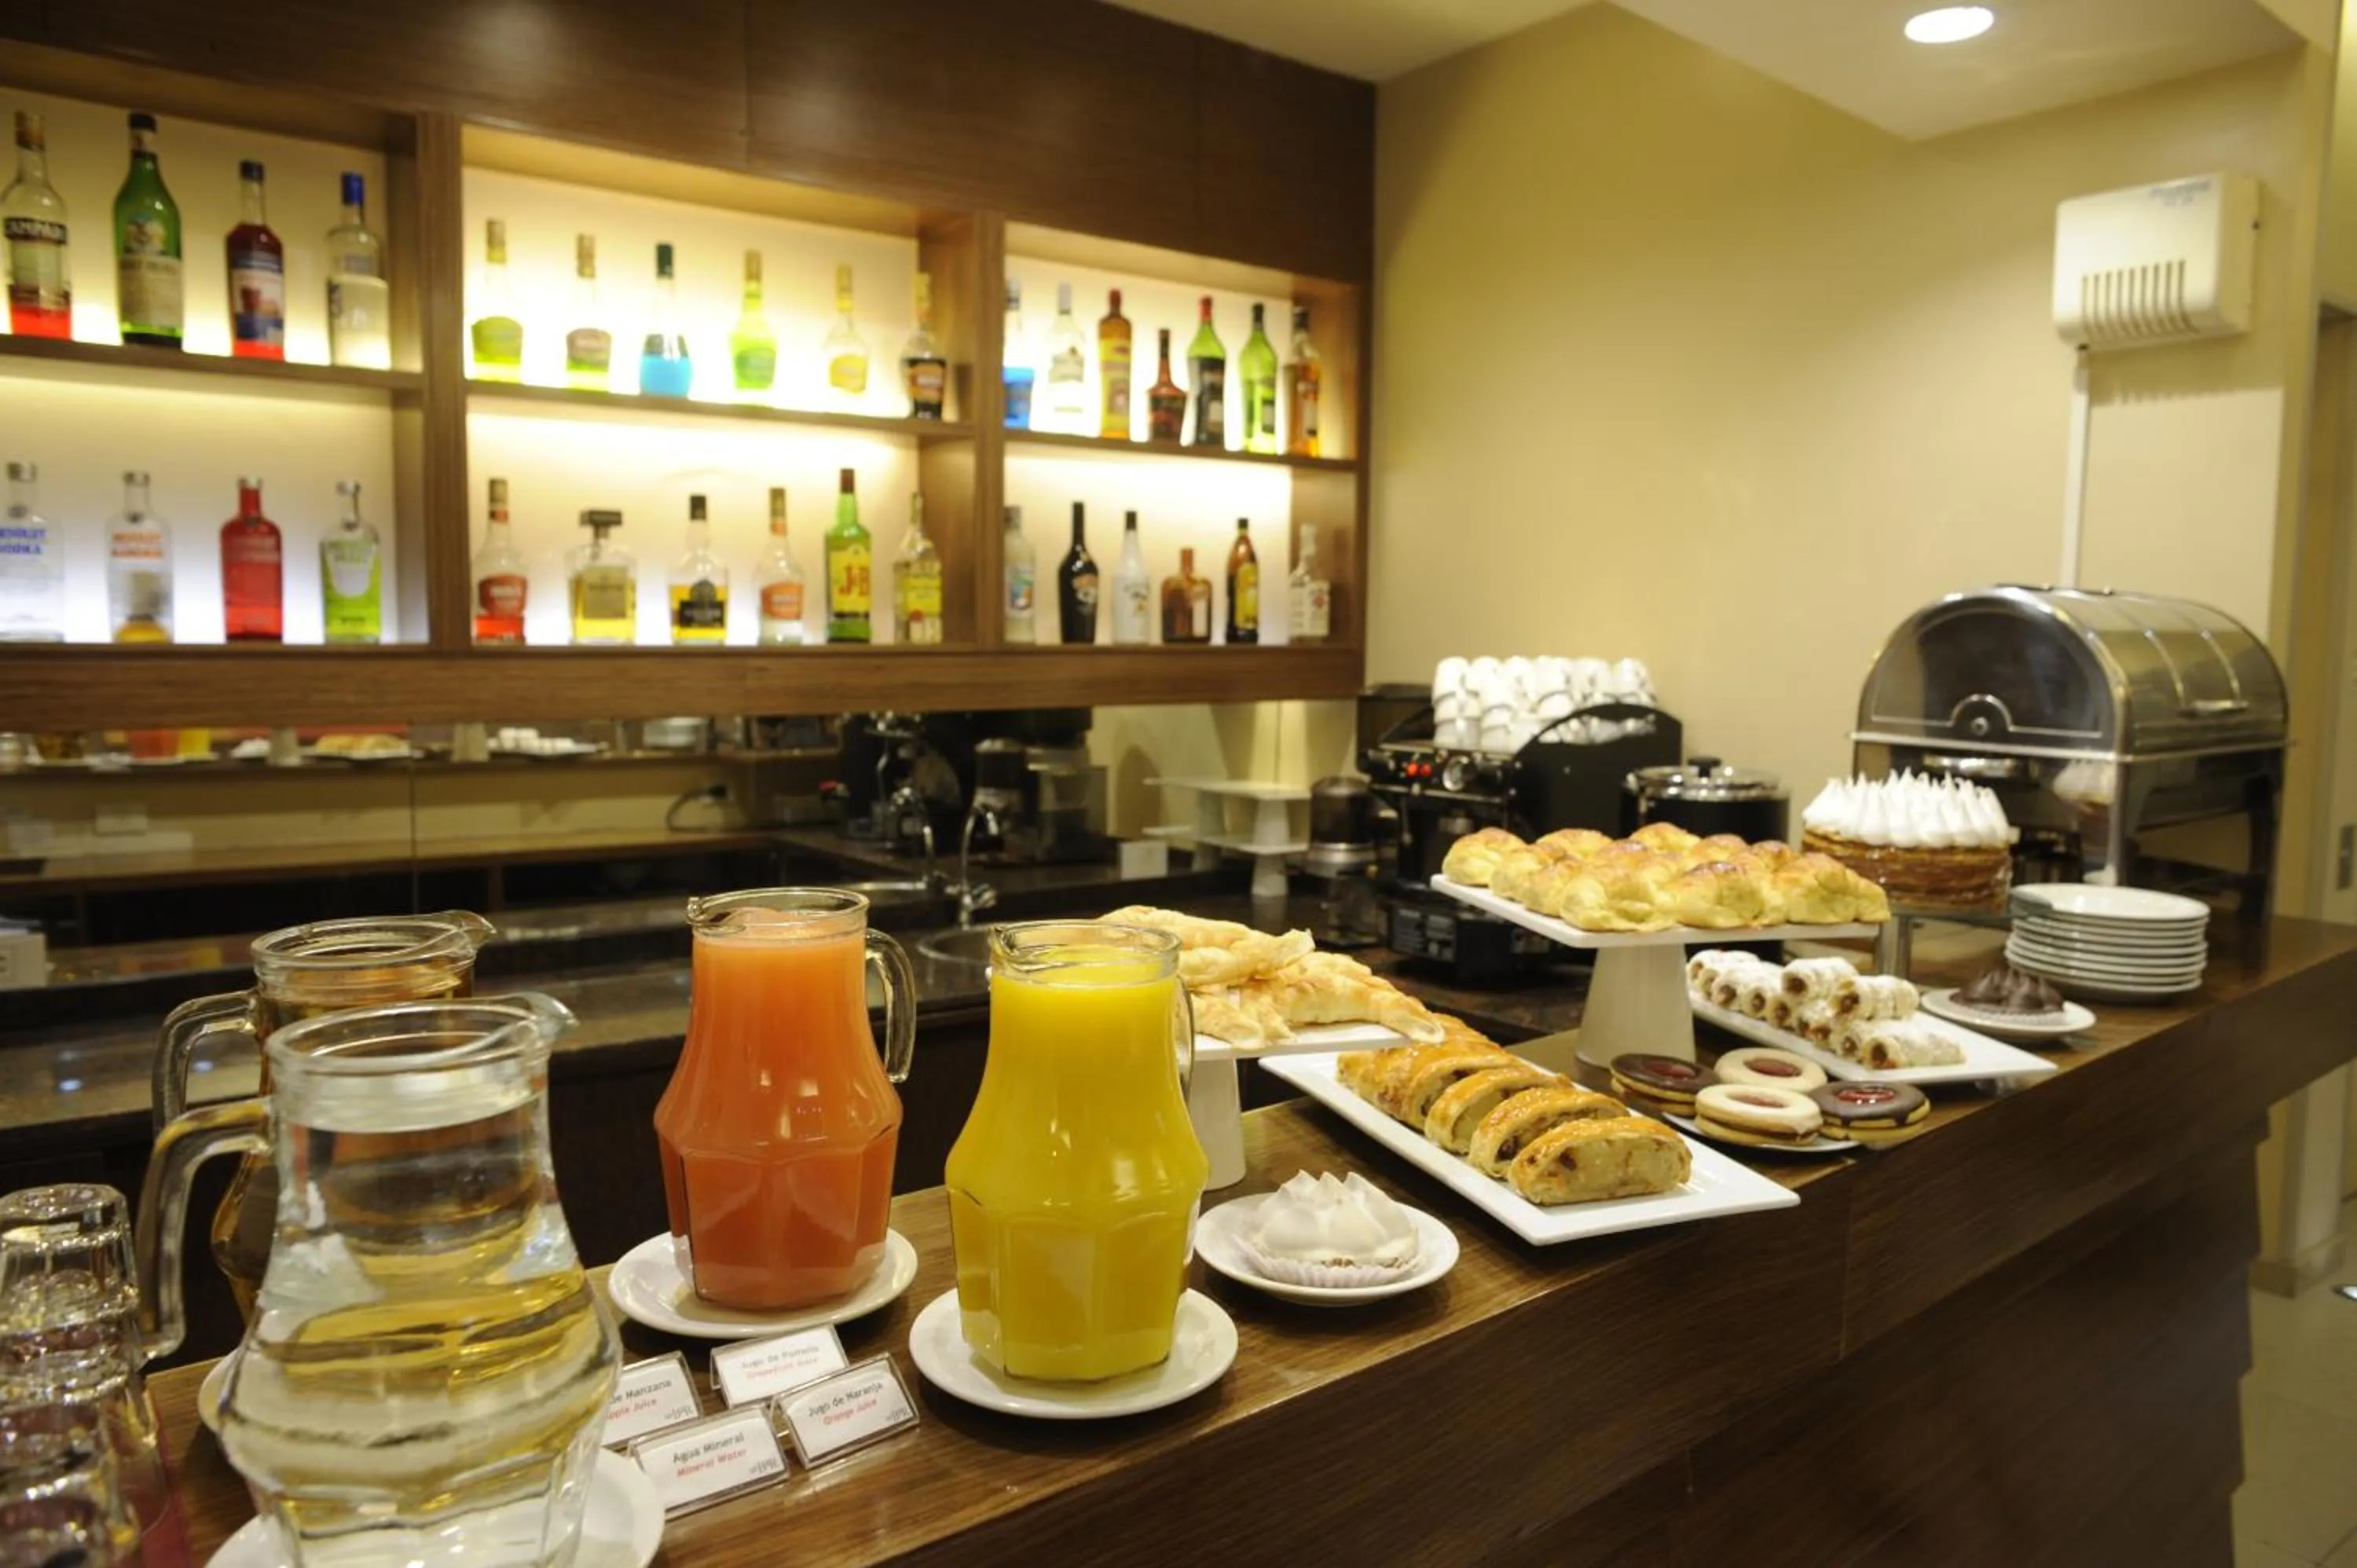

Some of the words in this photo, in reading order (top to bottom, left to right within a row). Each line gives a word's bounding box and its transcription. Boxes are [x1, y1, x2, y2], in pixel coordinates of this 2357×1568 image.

[625, 1379, 673, 1398] Manzana
[807, 1402, 831, 1418] Jugo
[833, 1396, 845, 1408] de
[845, 1381, 884, 1401] Naranja
[633, 1398, 658, 1412] Juice
[822, 1408, 854, 1427] Orange
[673, 1448, 702, 1464] Agua
[703, 1431, 746, 1453] Mineral
[676, 1458, 715, 1478] Mineral
[717, 1448, 747, 1464] Water
